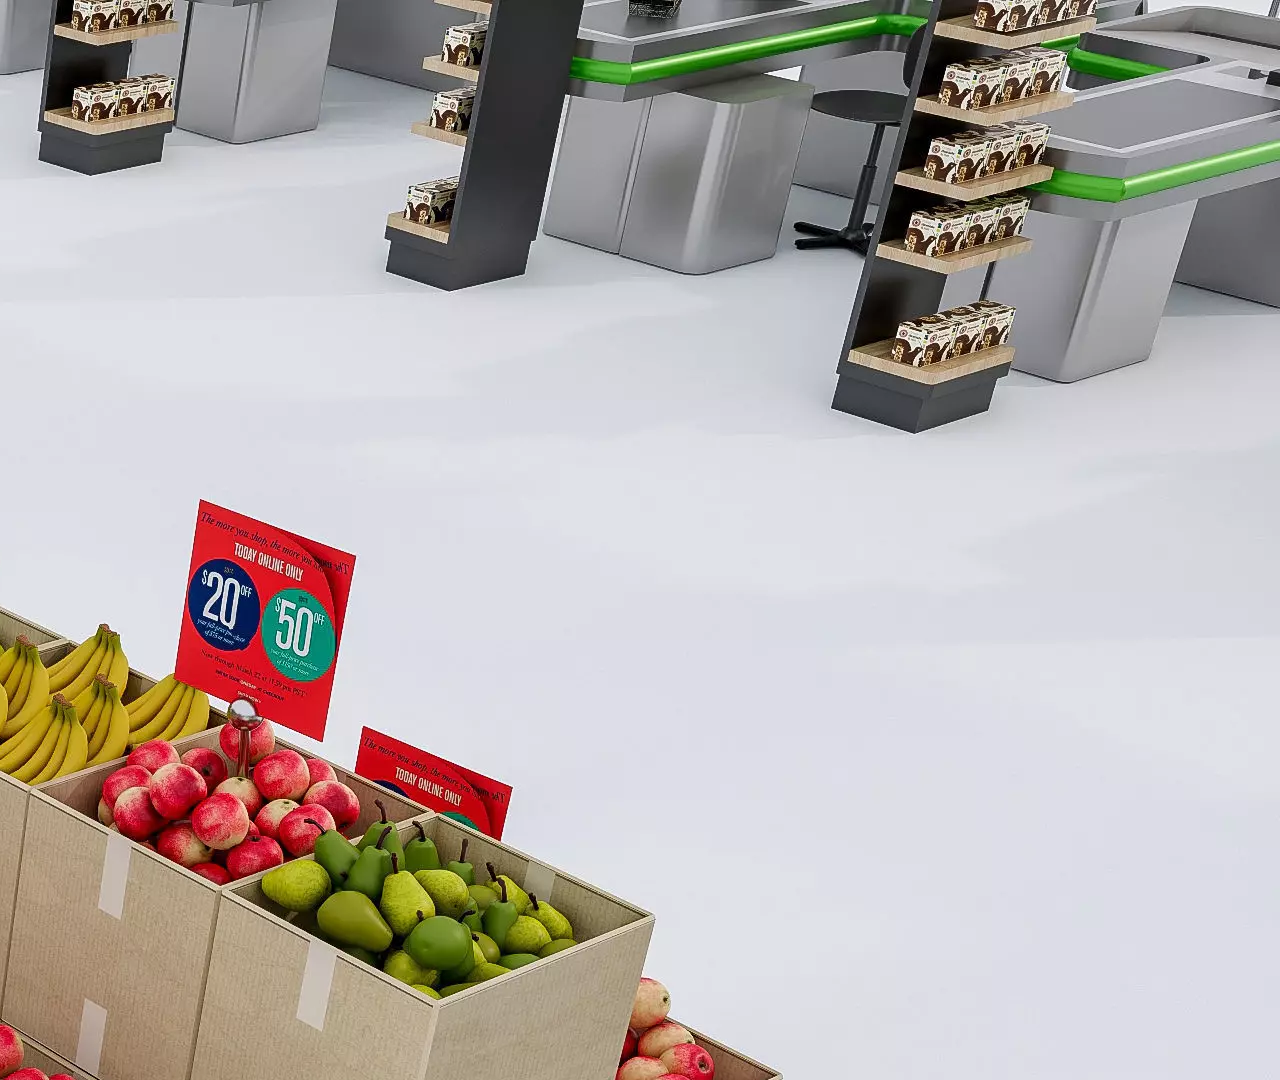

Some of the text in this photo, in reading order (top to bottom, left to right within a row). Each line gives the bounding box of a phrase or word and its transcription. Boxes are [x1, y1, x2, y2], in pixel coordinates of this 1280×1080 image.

[235, 543, 303, 581] TODAY ONLINE ONLY
[396, 767, 461, 806] TODAY ONLINE ONLY
